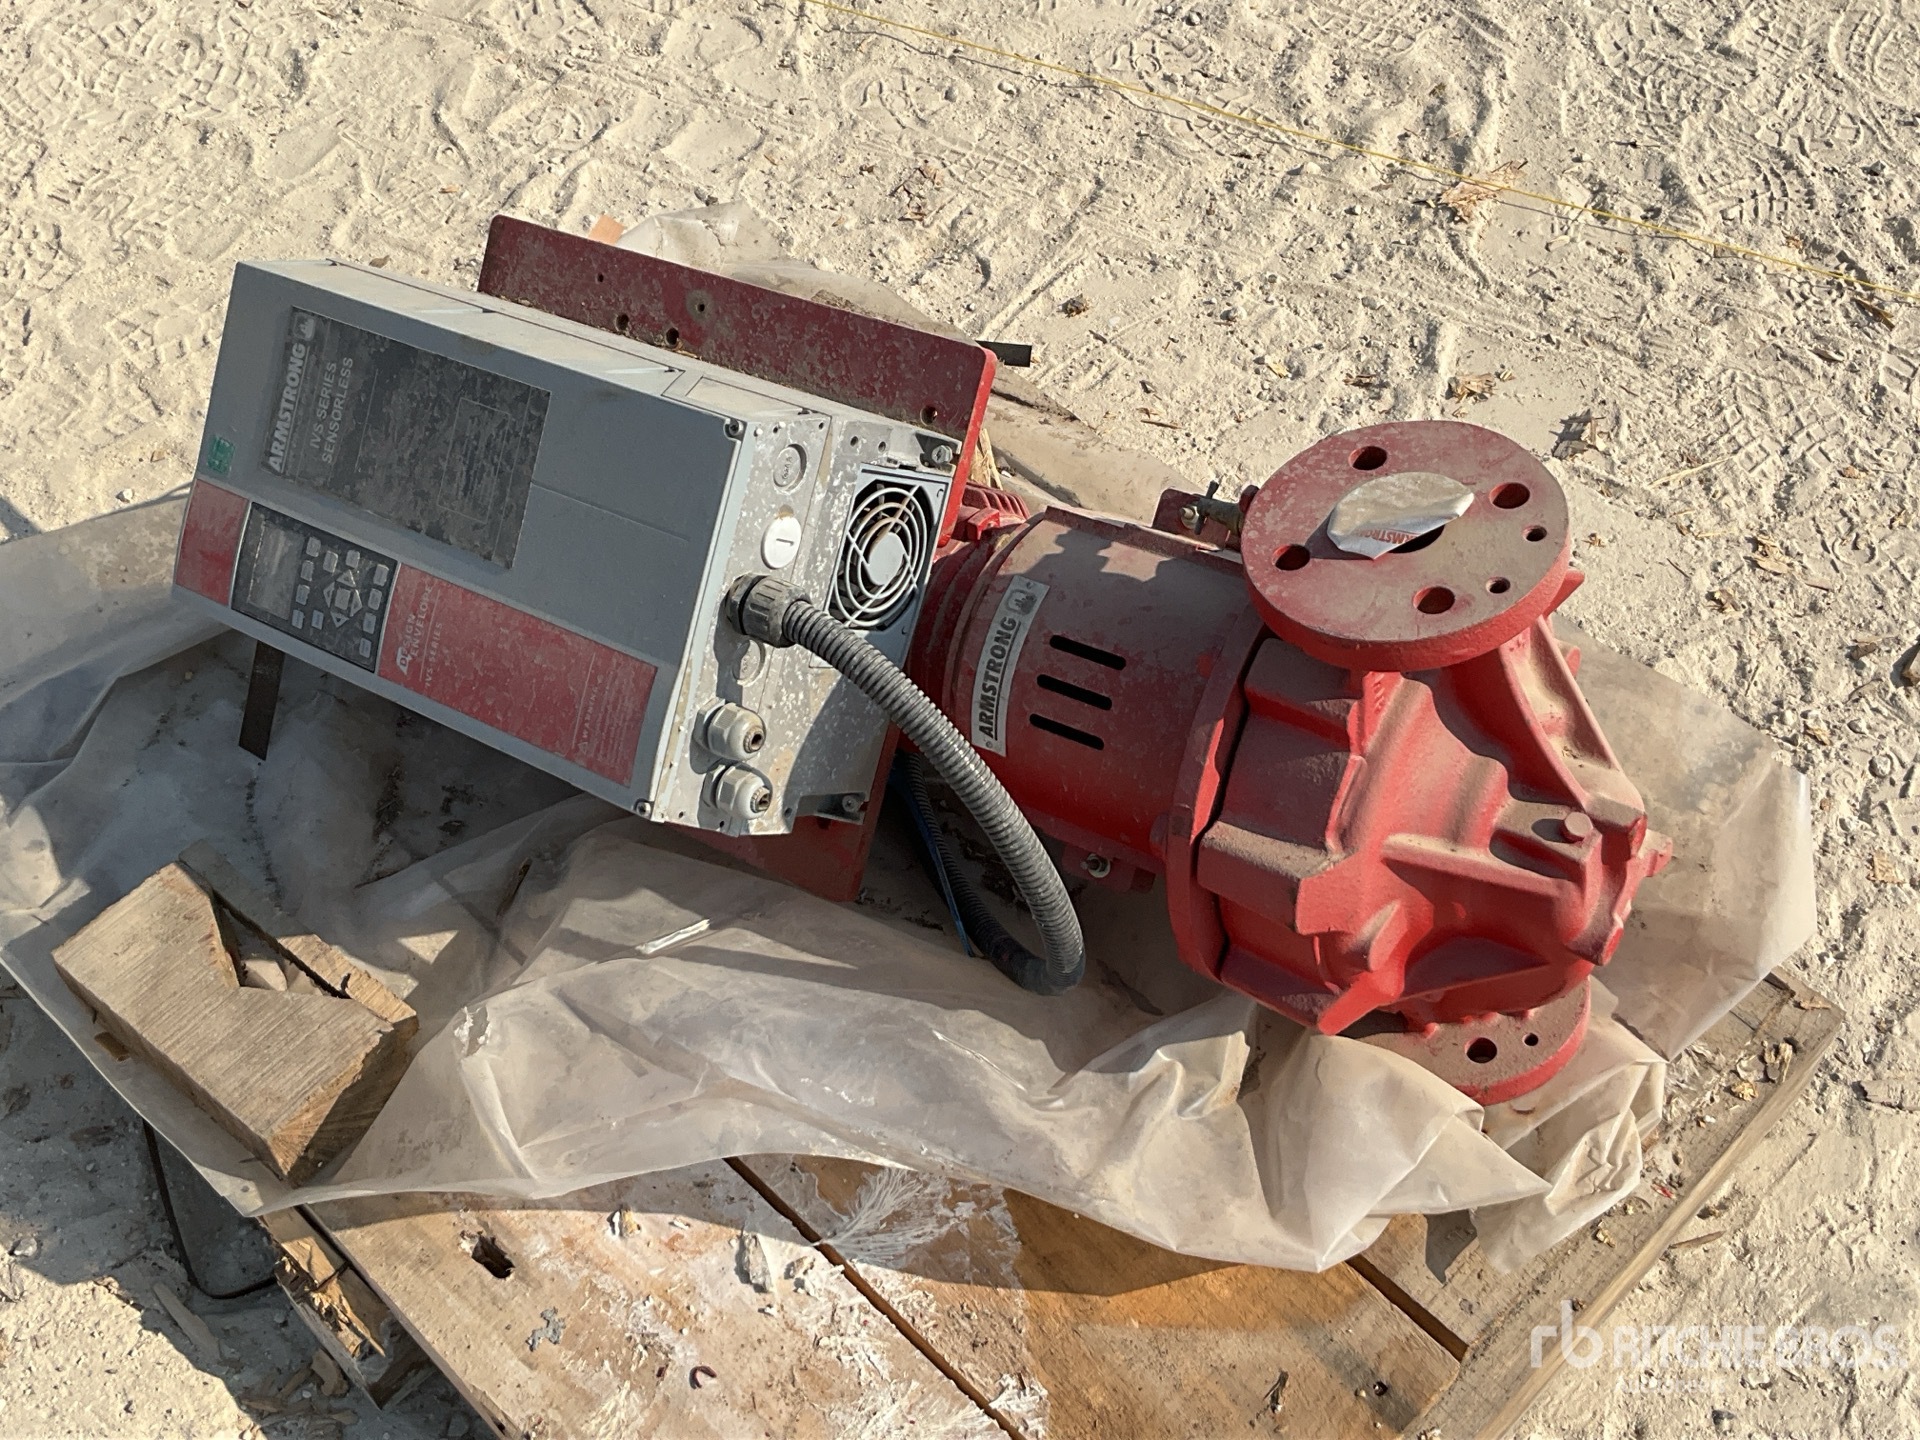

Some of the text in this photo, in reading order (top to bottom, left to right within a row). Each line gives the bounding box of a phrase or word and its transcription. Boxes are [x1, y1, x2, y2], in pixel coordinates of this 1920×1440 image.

[268, 343, 306, 472] ARMSTRONG
[310, 362, 337, 449] IVS SERIES
[322, 357, 354, 464] SENSORLESS
[410, 585, 433, 658] ENVELOPE
[425, 622, 443, 688] IVS SERIES
[978, 616, 1017, 739] ARMSTRONG
